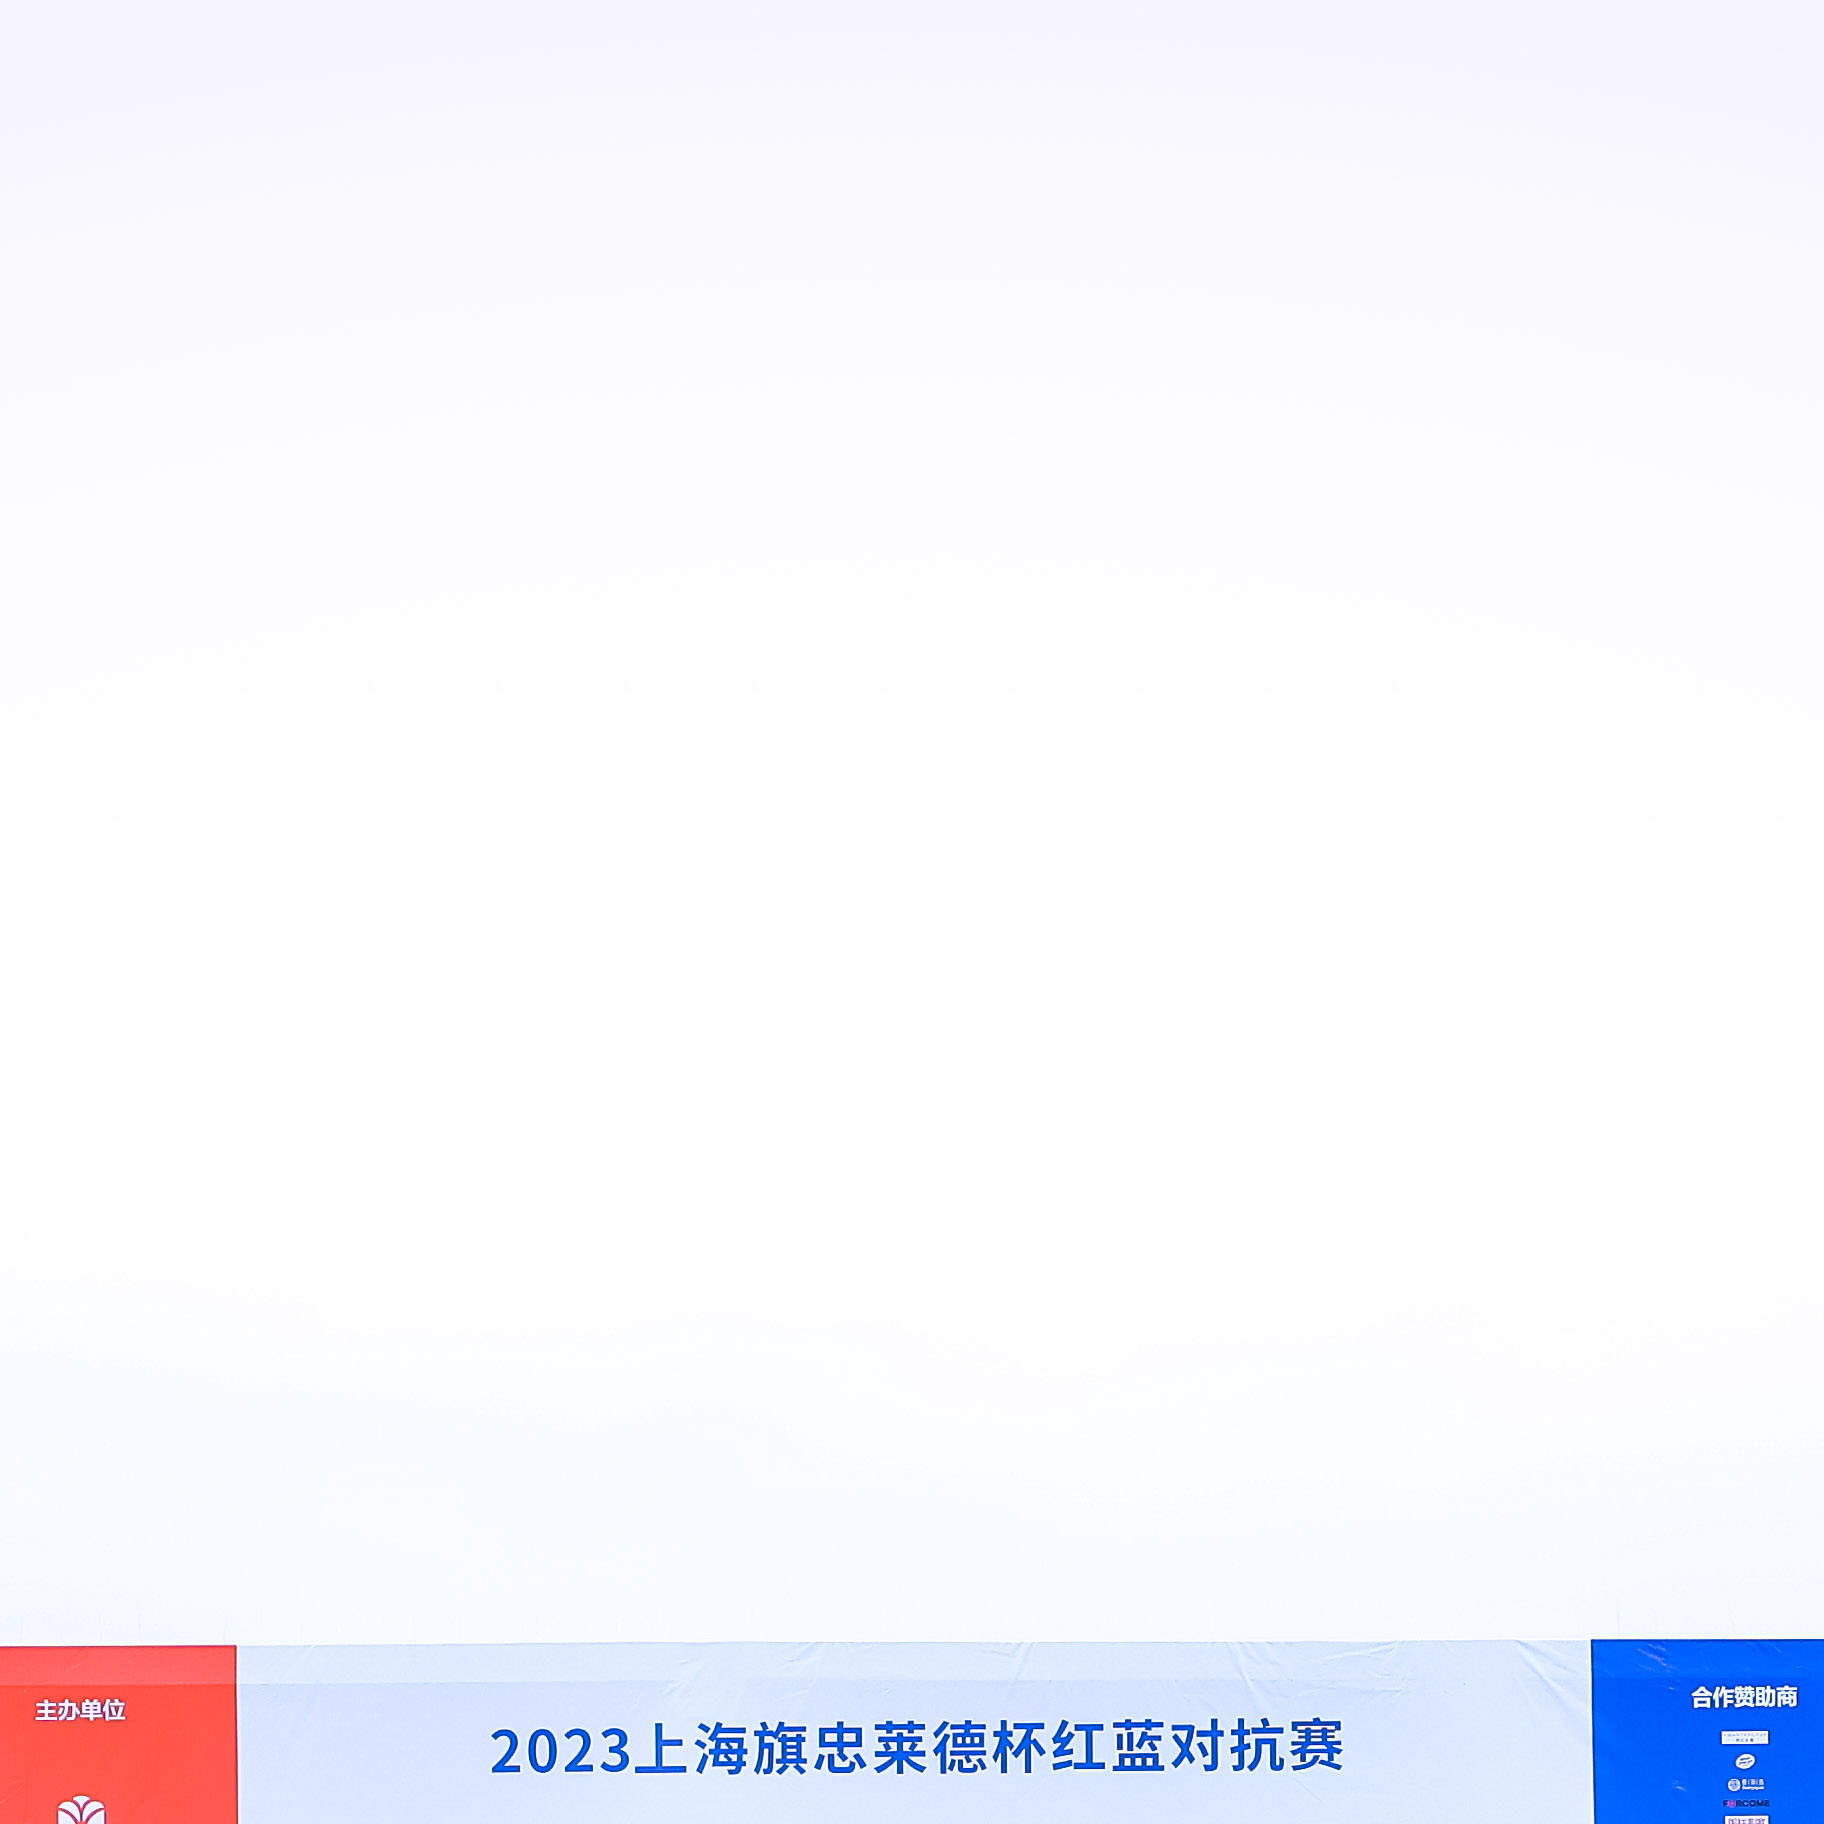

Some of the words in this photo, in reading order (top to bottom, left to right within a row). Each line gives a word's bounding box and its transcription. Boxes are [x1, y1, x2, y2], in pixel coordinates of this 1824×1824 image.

[1691, 1685, 1798, 1708] 合作赞助商
[35, 1699, 126, 1721] 主办单位
[490, 1717, 1344, 1775] 2023上海旗忠莱德杯红蓝对抗赛
